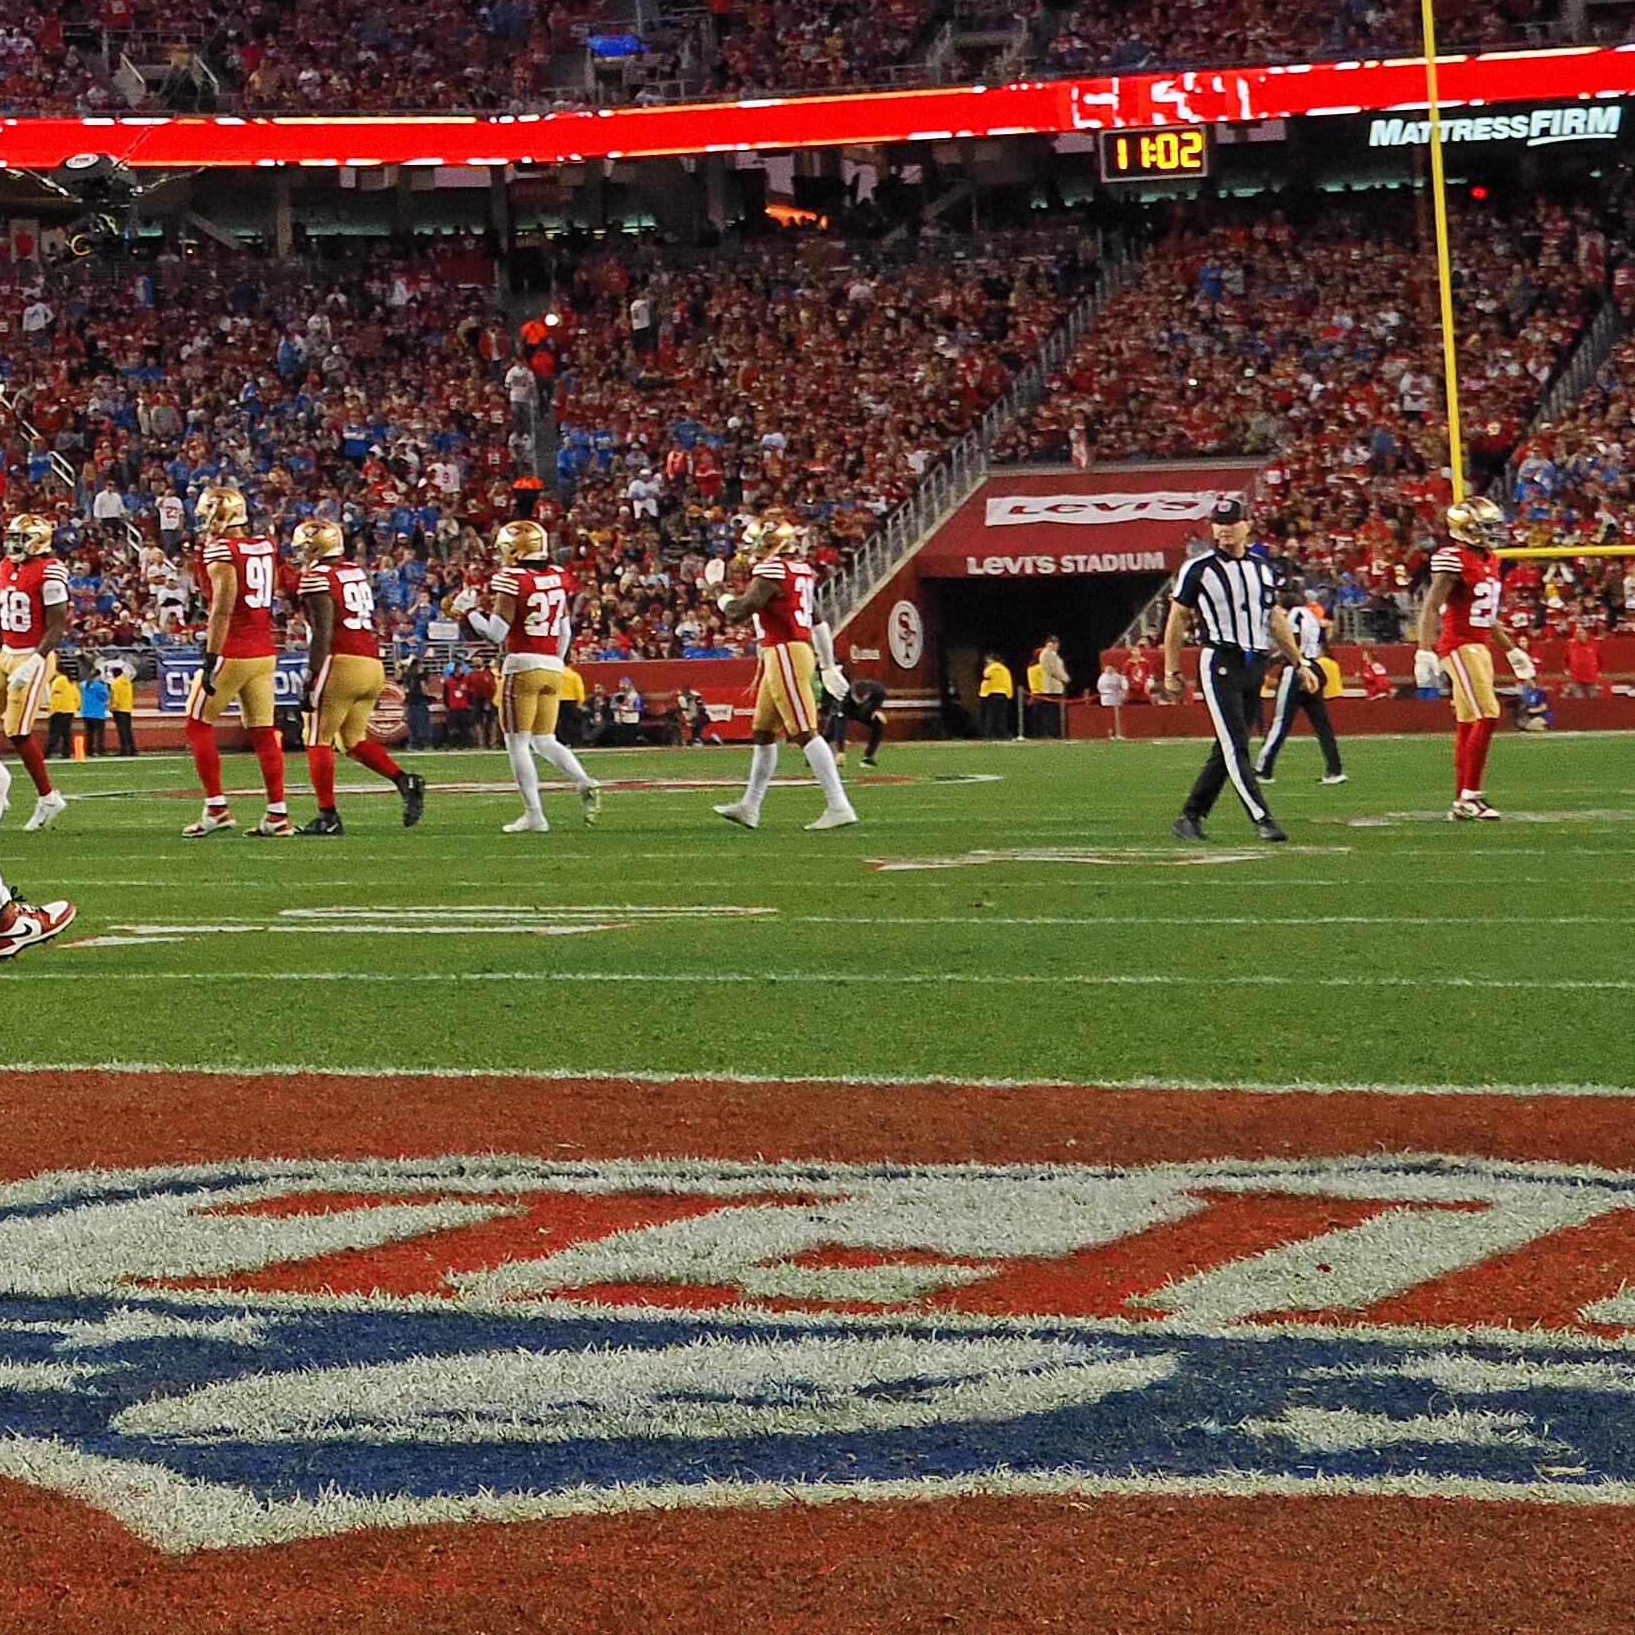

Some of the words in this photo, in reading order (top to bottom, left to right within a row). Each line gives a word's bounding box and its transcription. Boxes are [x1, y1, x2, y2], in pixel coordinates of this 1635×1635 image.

[1116, 131, 1203, 170] 11:02
[244, 554, 273, 608] 91
[1060, 551, 1165, 573] STADIUM
[524, 588, 567, 636] 27
